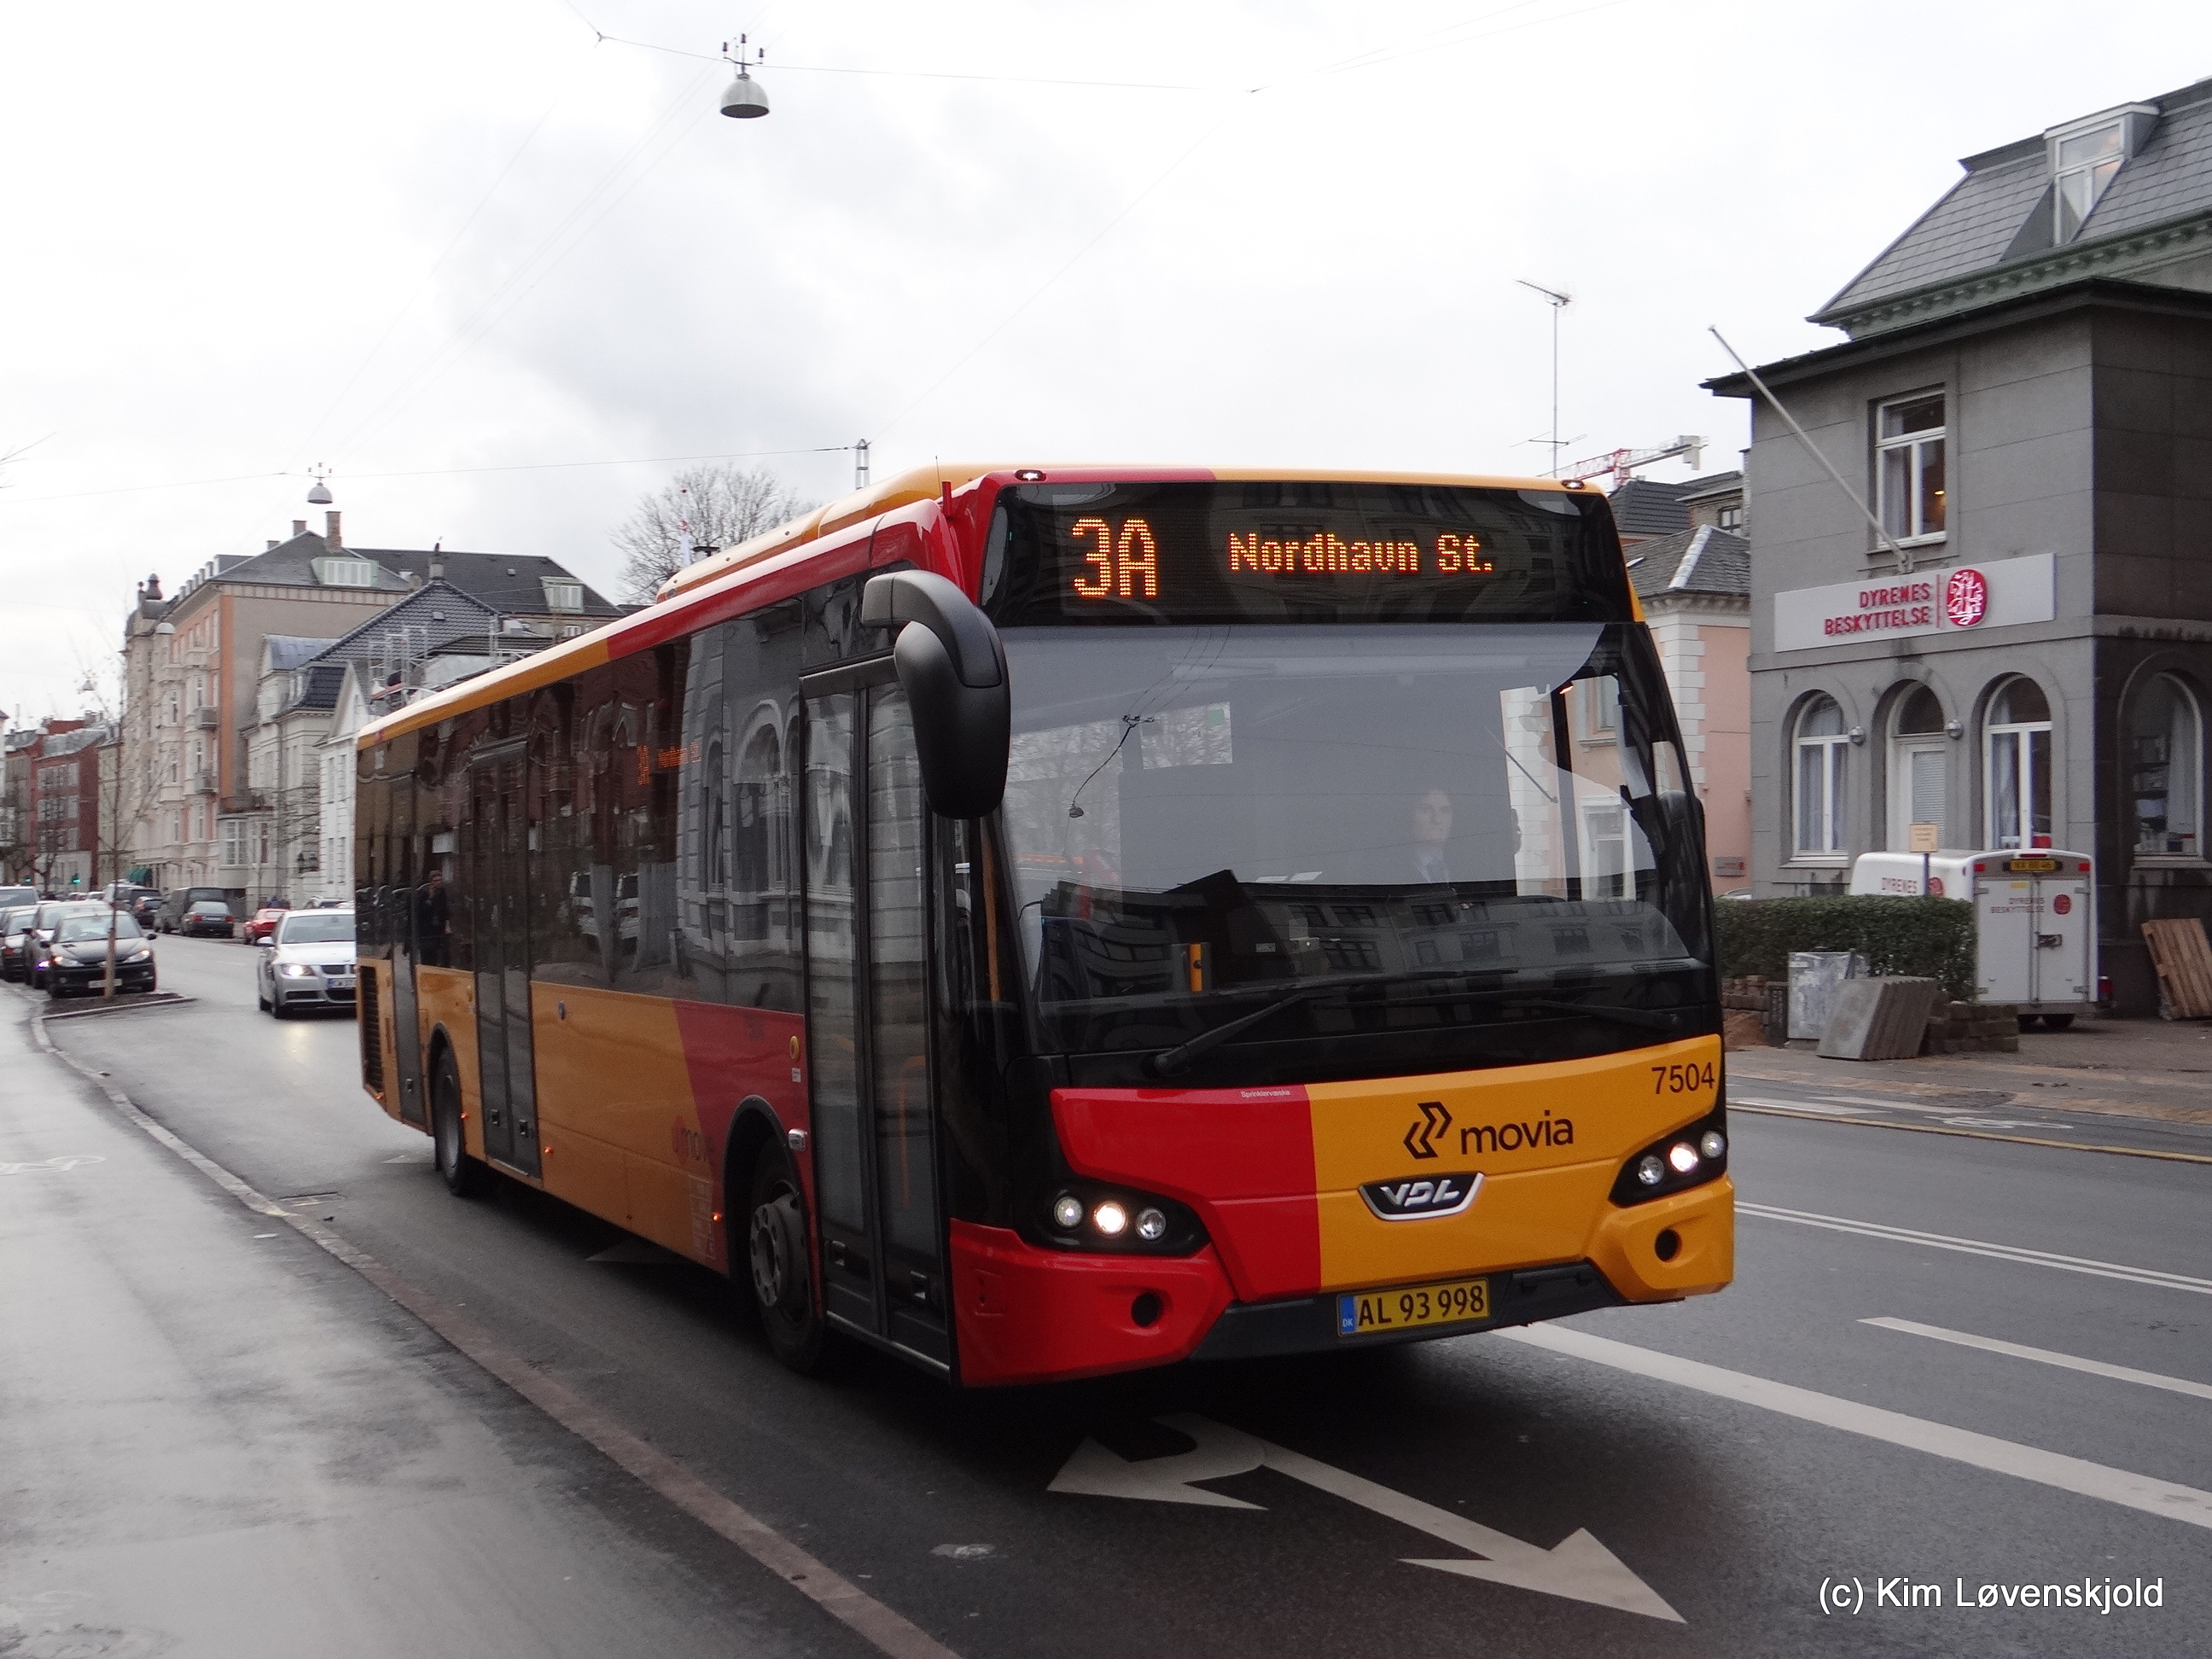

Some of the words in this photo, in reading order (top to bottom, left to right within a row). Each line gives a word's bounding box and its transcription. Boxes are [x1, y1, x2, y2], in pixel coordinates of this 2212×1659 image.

[1072, 518, 1157, 597] 3A
[1229, 533, 1419, 572] Nordhavn
[1436, 534, 1493, 572] St.
[1859, 583, 1931, 608] DYRENES
[1825, 606, 1930, 635] BESKYTTELSE
[1651, 1062, 1715, 1095] 7504
[1461, 1110, 1574, 1155] movia
[1379, 1179, 1462, 1208] VDL
[1358, 1297, 1393, 1326] AL
[1400, 1292, 1430, 1321] 93
[1437, 1285, 1484, 1318] 998
